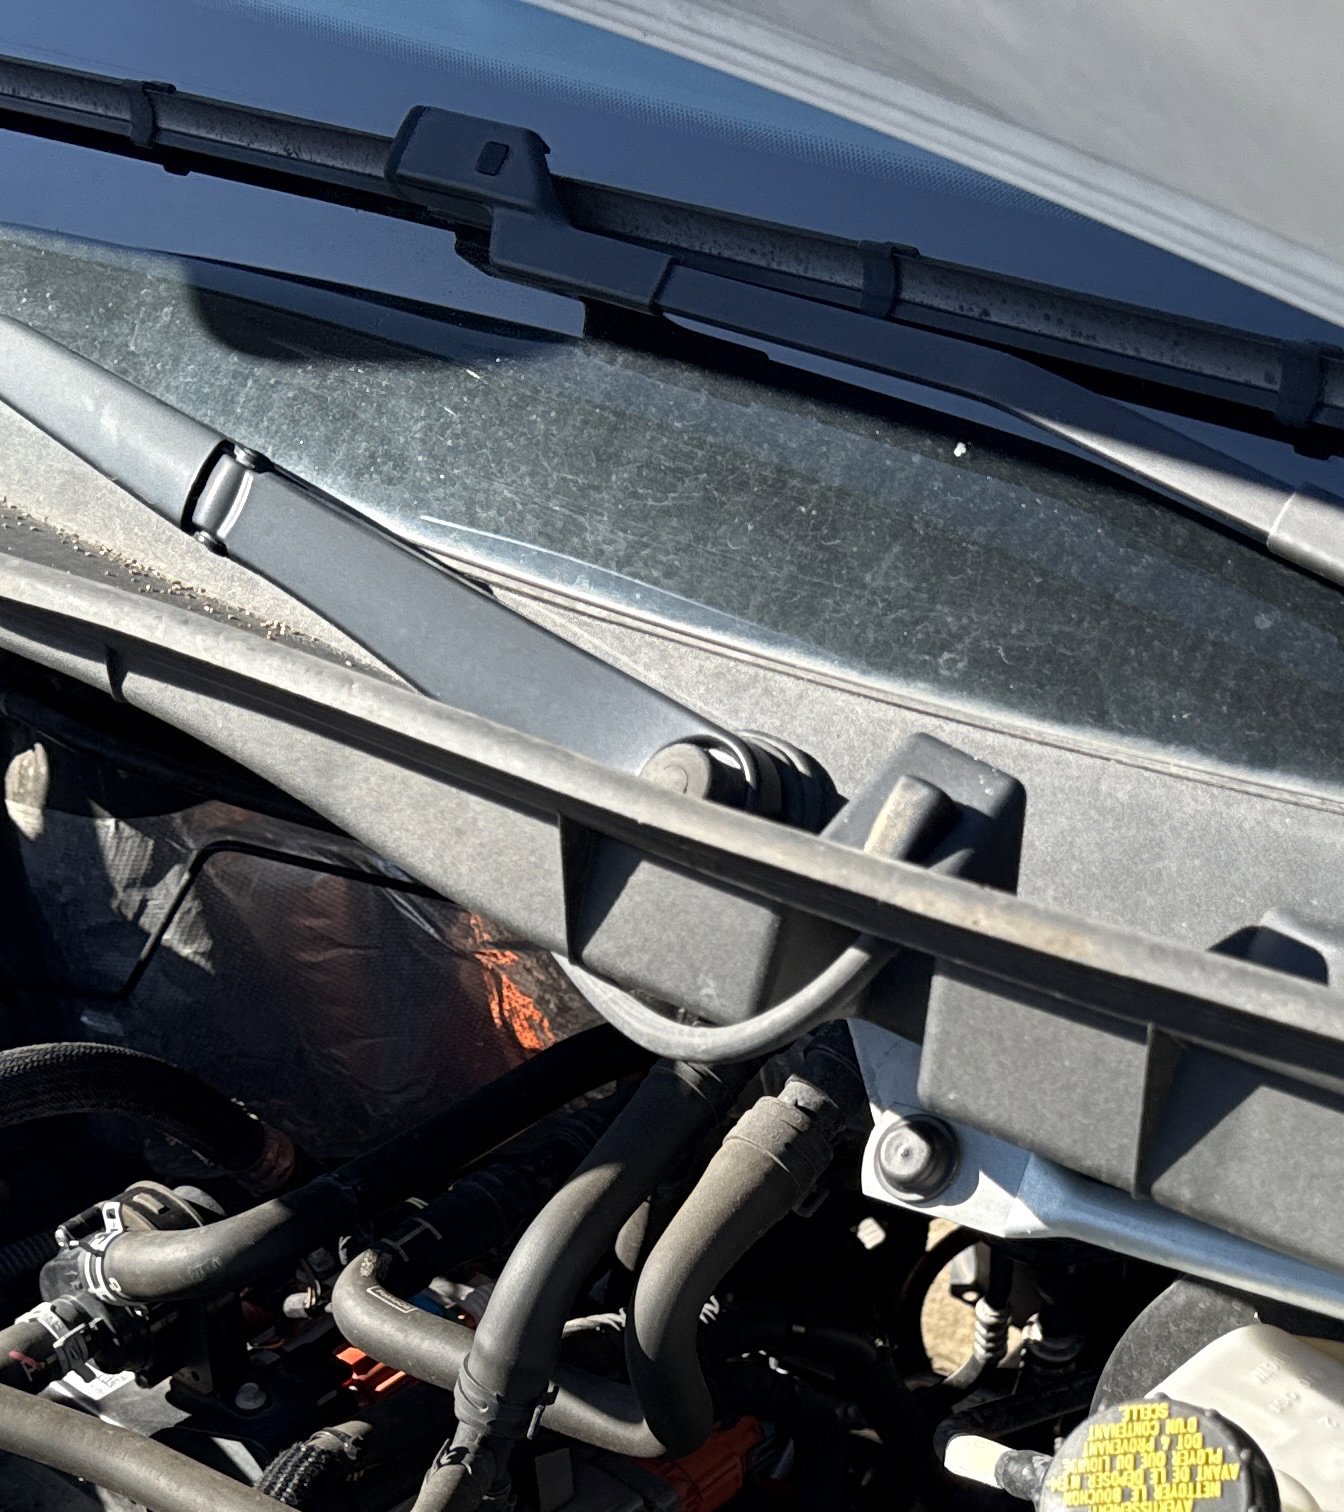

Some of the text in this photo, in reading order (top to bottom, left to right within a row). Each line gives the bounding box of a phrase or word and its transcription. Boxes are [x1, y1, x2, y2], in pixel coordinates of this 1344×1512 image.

[1087, 1420, 1159, 1438] CONTENANT
[1082, 1436, 1154, 1455] PROVENANT
[1175, 1433, 1202, 1449] DOT
[1116, 1453, 1133, 1468] DU
[1138, 1451, 1165, 1467] QUE
[1171, 1447, 1222, 1465] PLOYER
[1149, 1467, 1165, 1482] LE
[1172, 1465, 1190, 1481] DE
[1196, 1462, 1239, 1480] AVANT
[1063, 1481, 1220, 1504] NETTOYER LE BOUCHON
